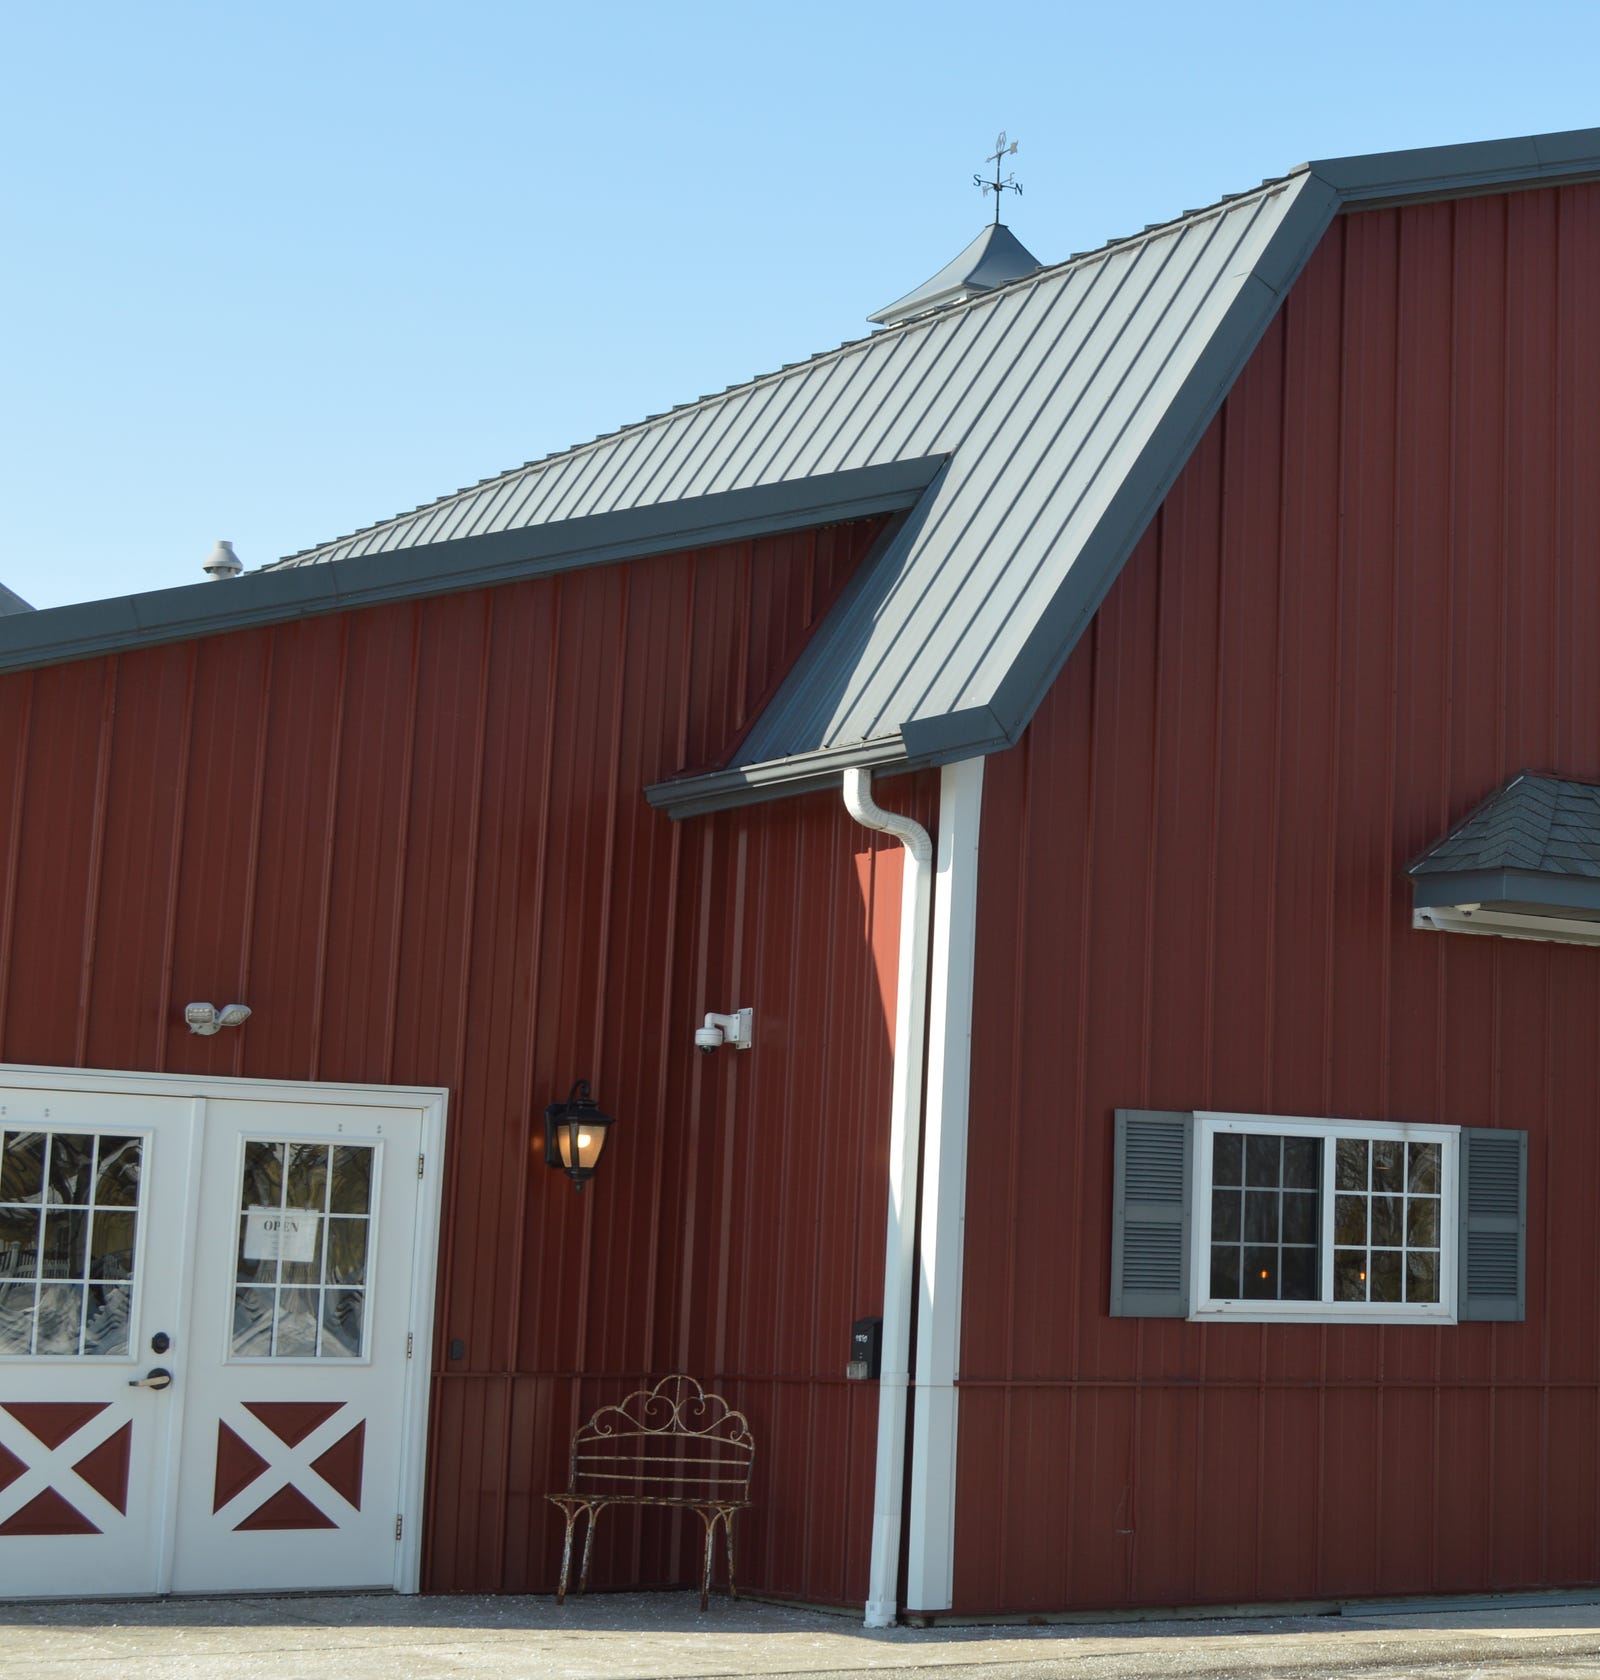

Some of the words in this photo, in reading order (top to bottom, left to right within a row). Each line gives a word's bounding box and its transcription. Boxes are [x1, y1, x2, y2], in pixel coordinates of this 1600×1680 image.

[973, 174, 981, 187] S
[1015, 183, 1023, 196] N
[263, 1220, 299, 1233] OPEN
